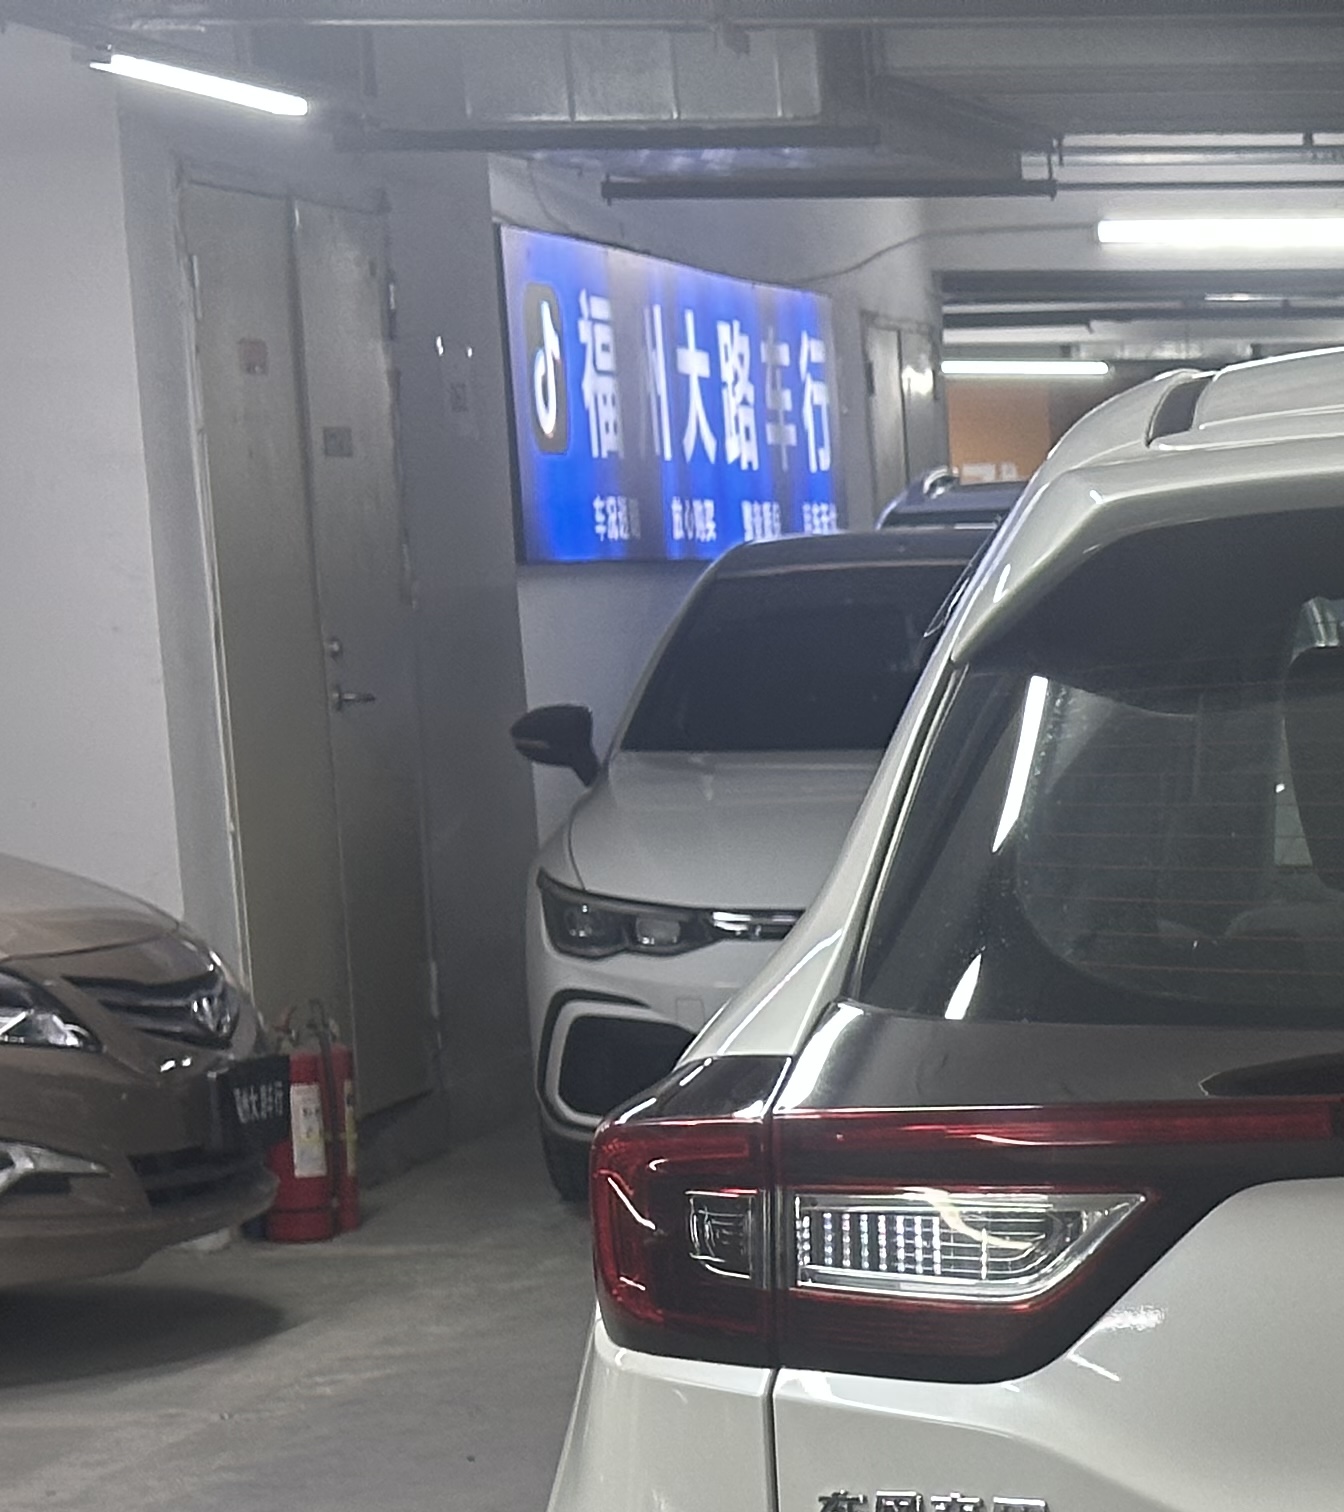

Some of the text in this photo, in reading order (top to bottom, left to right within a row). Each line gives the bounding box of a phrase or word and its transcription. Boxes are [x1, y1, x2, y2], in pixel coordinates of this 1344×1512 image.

[579, 288, 831, 473] 福州大路车行
